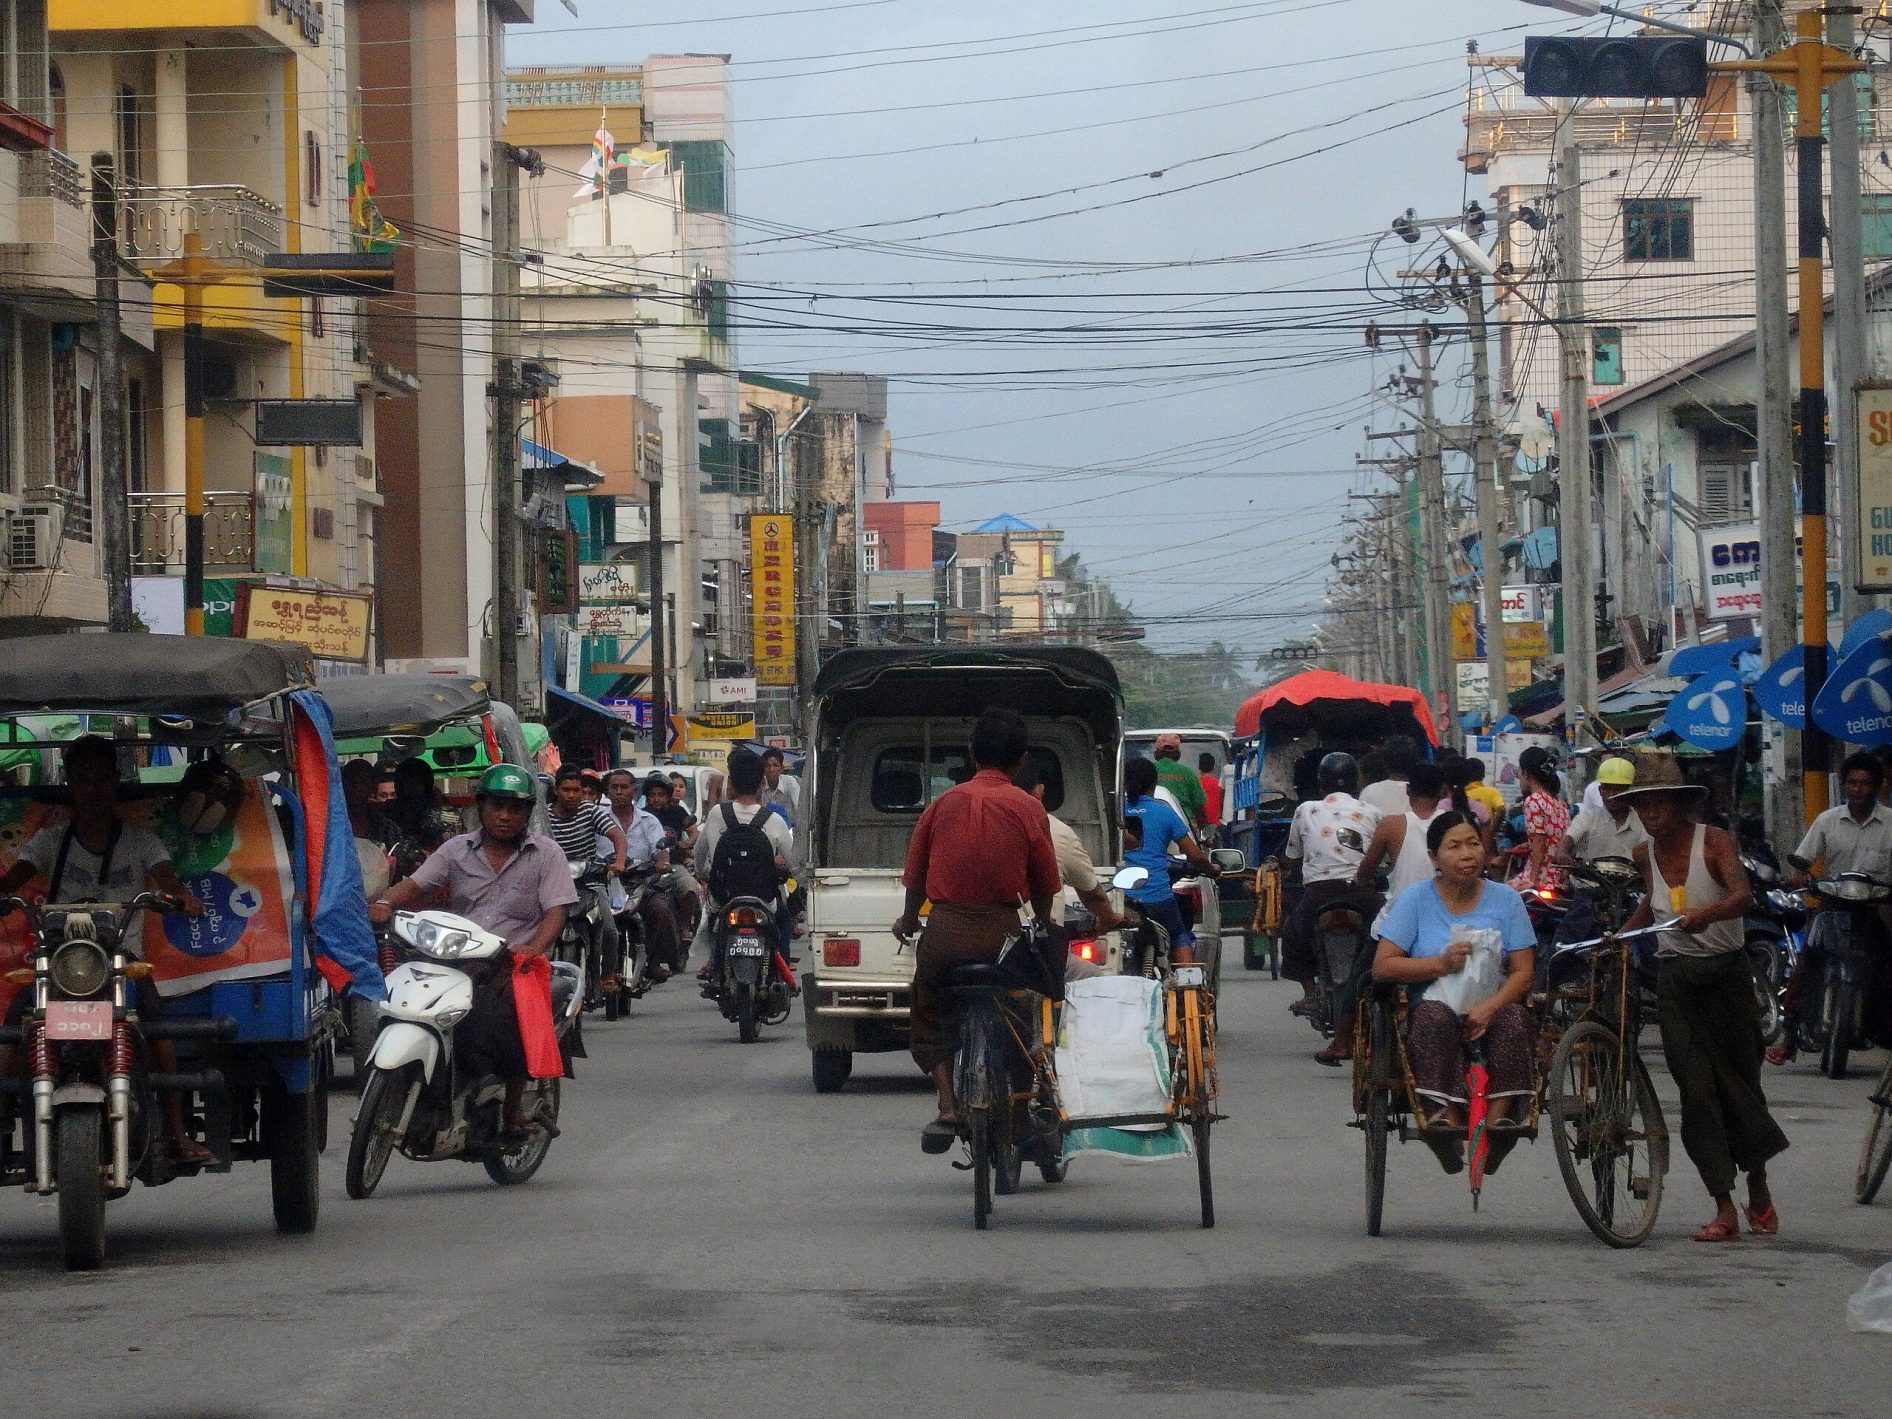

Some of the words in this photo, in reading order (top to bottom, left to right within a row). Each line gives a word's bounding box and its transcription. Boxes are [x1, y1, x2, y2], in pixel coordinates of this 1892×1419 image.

[1869, 410, 1892, 446] S
[1782, 701, 1805, 715] tele
[1689, 723, 1732, 737] telenor
[1847, 715, 1892, 735] teleno
[184, 880, 202, 948] Facek
